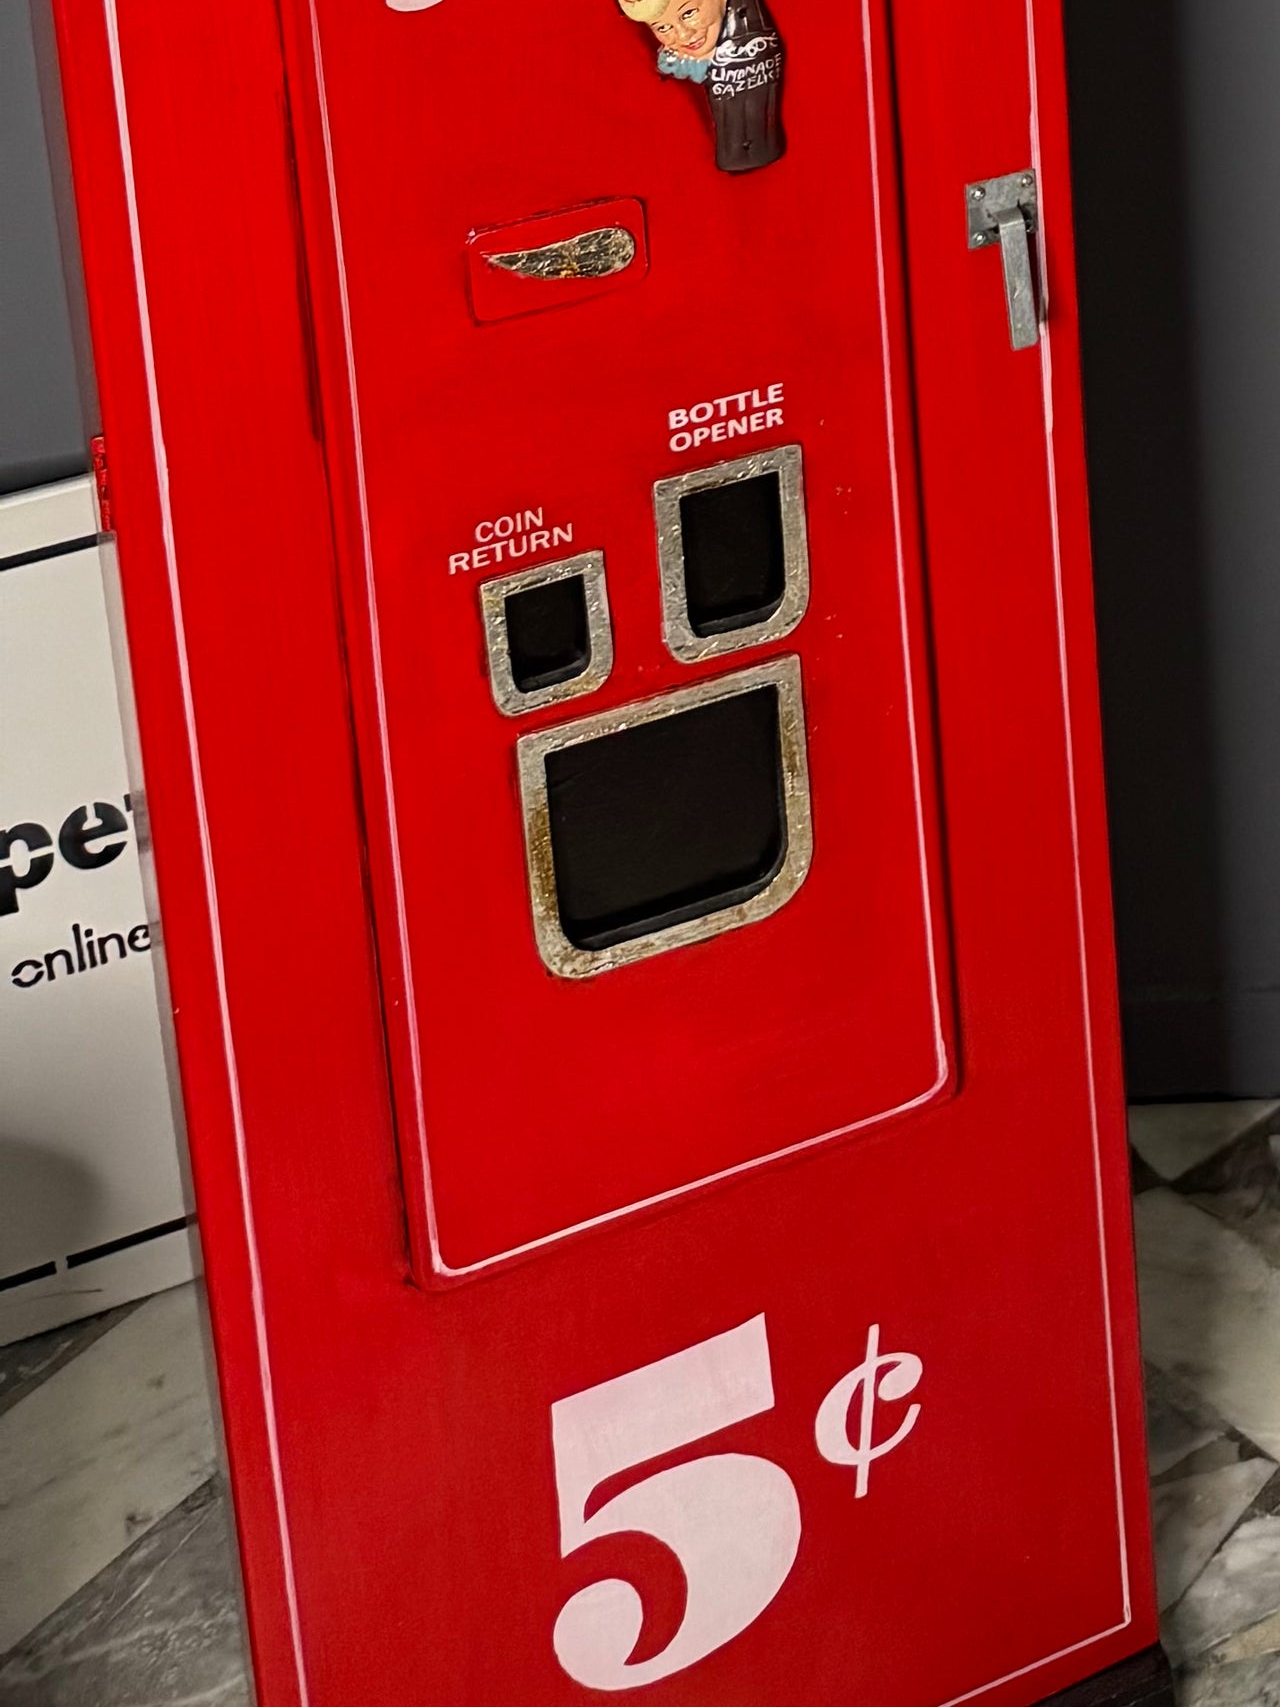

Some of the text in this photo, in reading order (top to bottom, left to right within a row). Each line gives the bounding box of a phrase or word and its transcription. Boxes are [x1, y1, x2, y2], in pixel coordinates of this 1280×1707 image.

[668, 383, 784, 430] BOTTLE
[669, 408, 784, 453] OPENER
[449, 523, 573, 575] RETURN
[475, 506, 543, 543] COIN
[11, 923, 152, 988] online
[551, 1312, 923, 1691] 5¢
